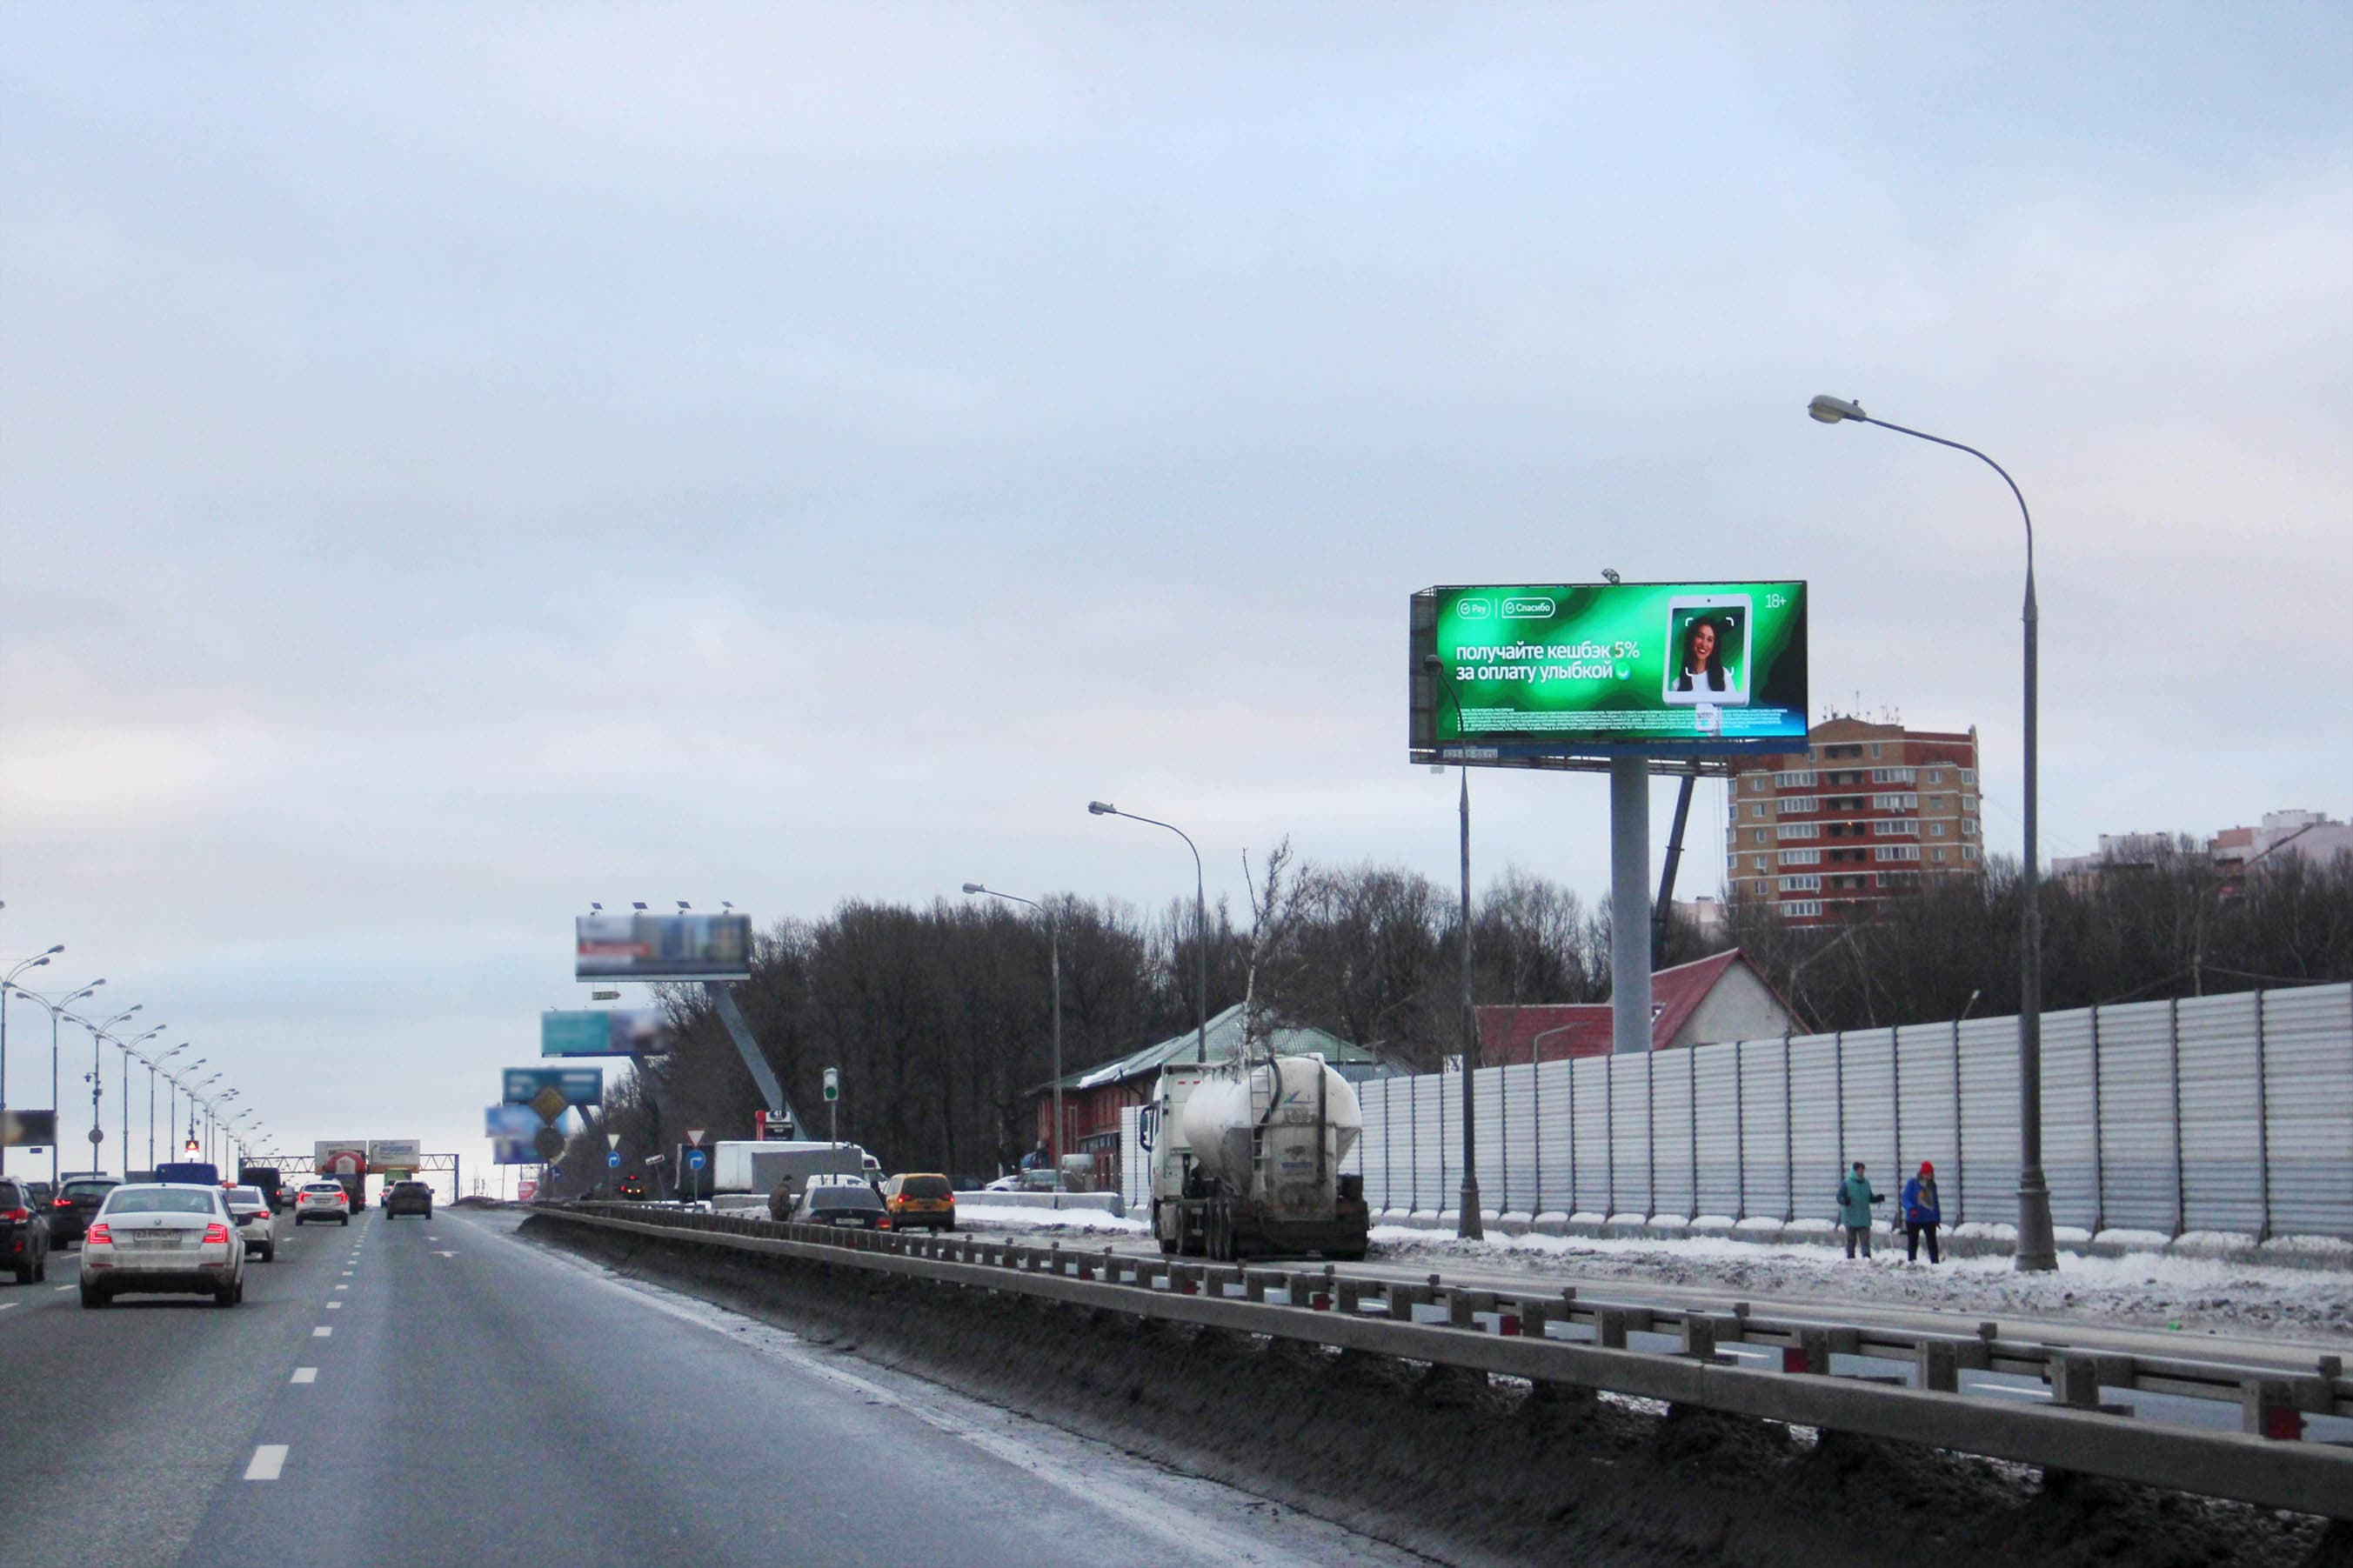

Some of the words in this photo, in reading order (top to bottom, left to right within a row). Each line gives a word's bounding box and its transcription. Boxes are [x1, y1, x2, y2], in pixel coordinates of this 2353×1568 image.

[1516, 602, 1551, 612] Спасибо
[1765, 593, 1787, 609] 18+
[1456, 641, 1544, 664] получайте
[1547, 640, 1610, 659] кешбэк
[1614, 641, 1640, 658] 5%
[1456, 666, 1474, 680] за
[1478, 664, 1536, 684] оплату
[1539, 660, 1613, 682] улыбкой
